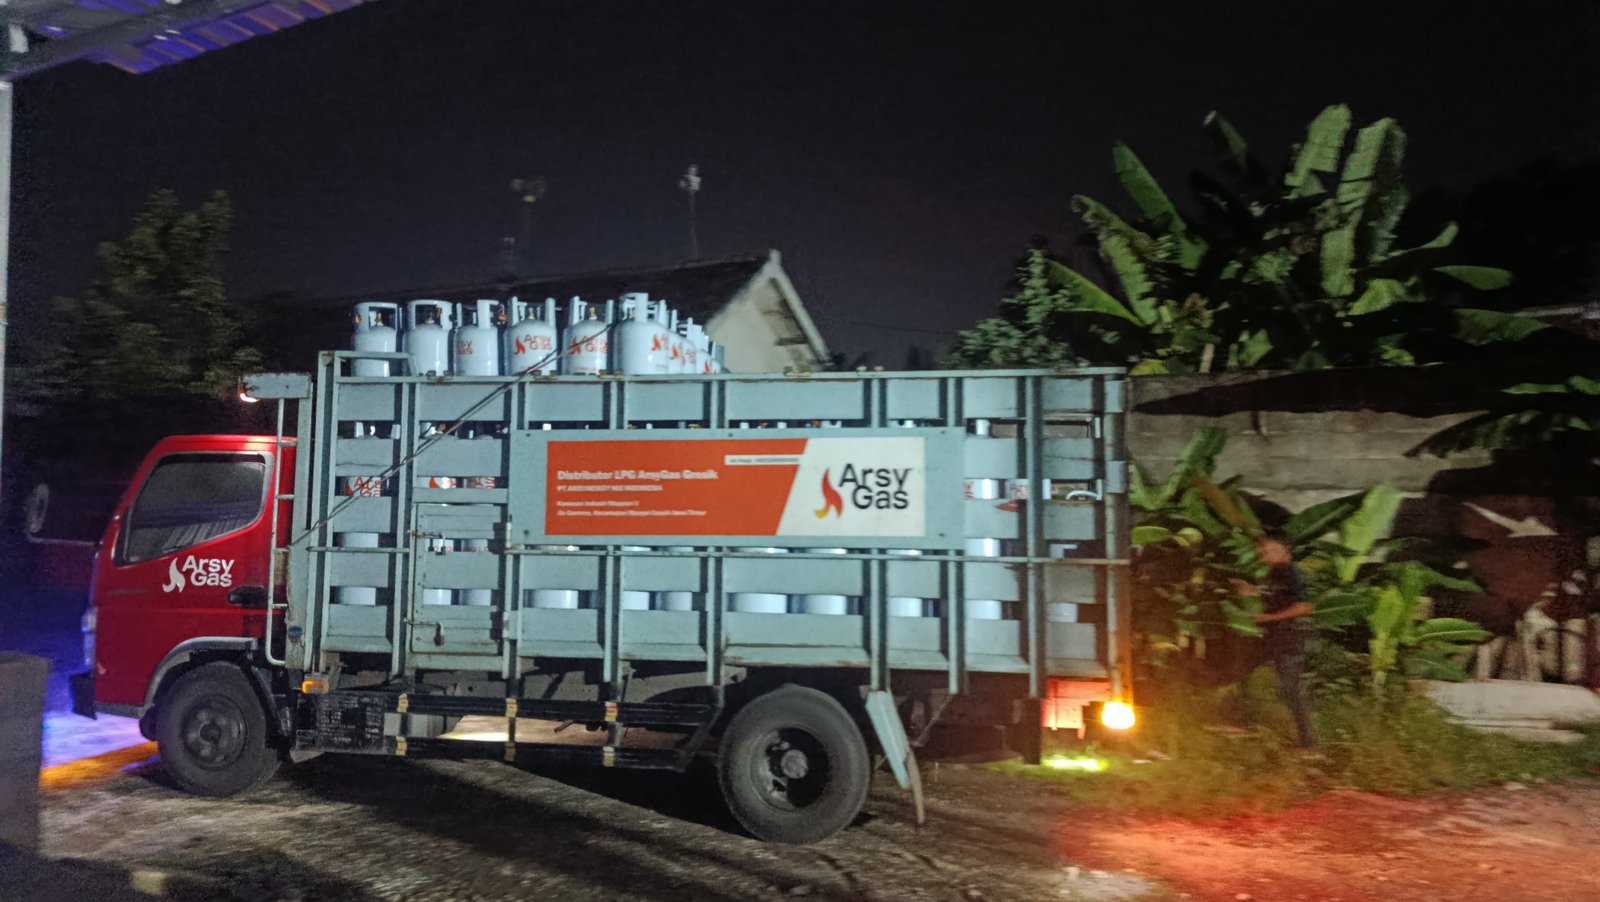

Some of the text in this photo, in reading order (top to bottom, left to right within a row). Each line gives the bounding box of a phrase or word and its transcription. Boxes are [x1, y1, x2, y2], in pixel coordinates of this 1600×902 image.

[614, 470, 636, 480] LPG
[838, 463, 914, 491] Arsy
[851, 485, 909, 510] Gas
[182, 555, 235, 574] Arsy
[190, 570, 232, 587] Gas
